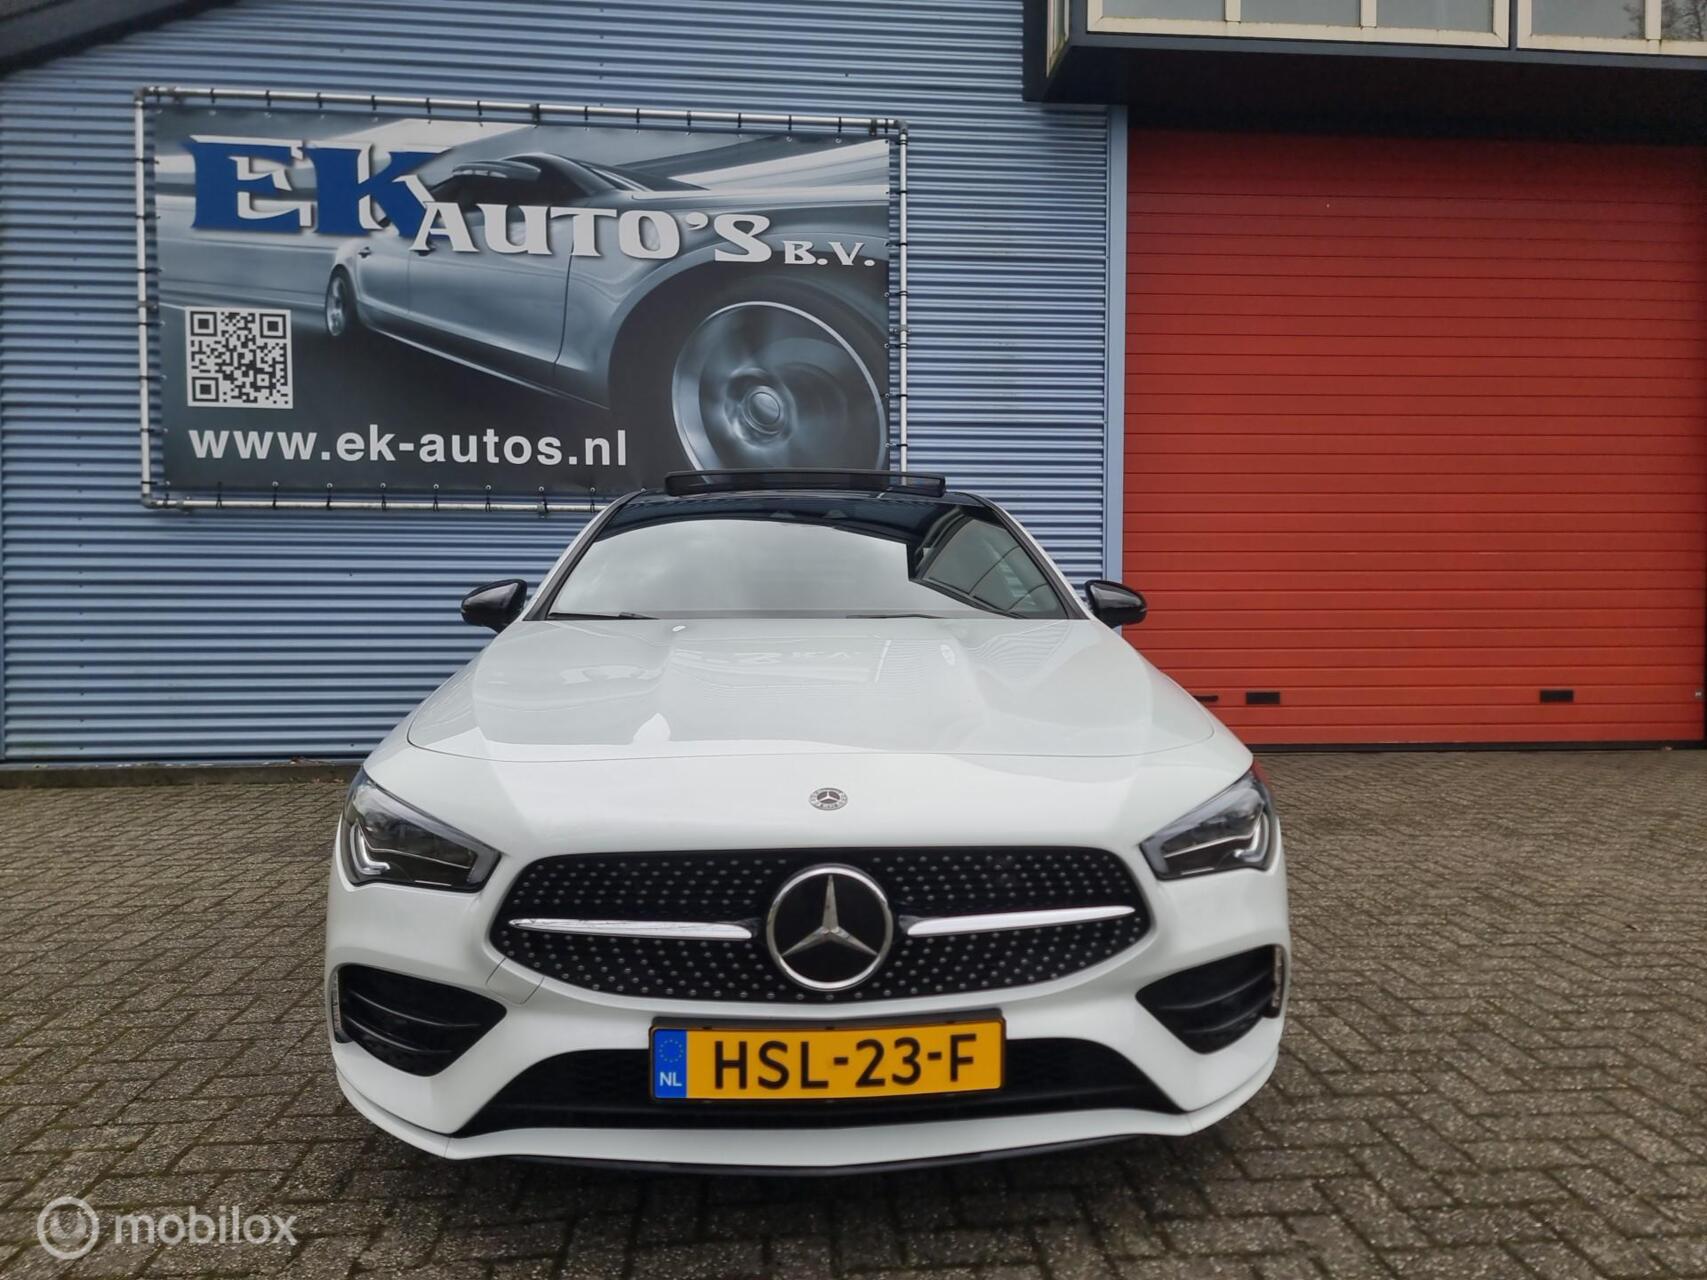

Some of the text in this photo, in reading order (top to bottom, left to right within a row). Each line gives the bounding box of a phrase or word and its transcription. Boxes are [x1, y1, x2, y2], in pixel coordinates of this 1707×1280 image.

[781, 240, 877, 267] B.V.
[188, 425, 627, 466] www.ek-autos.nl
[714, 1033, 977, 1090] HSL-23-F
[659, 1071, 682, 1087] NL
